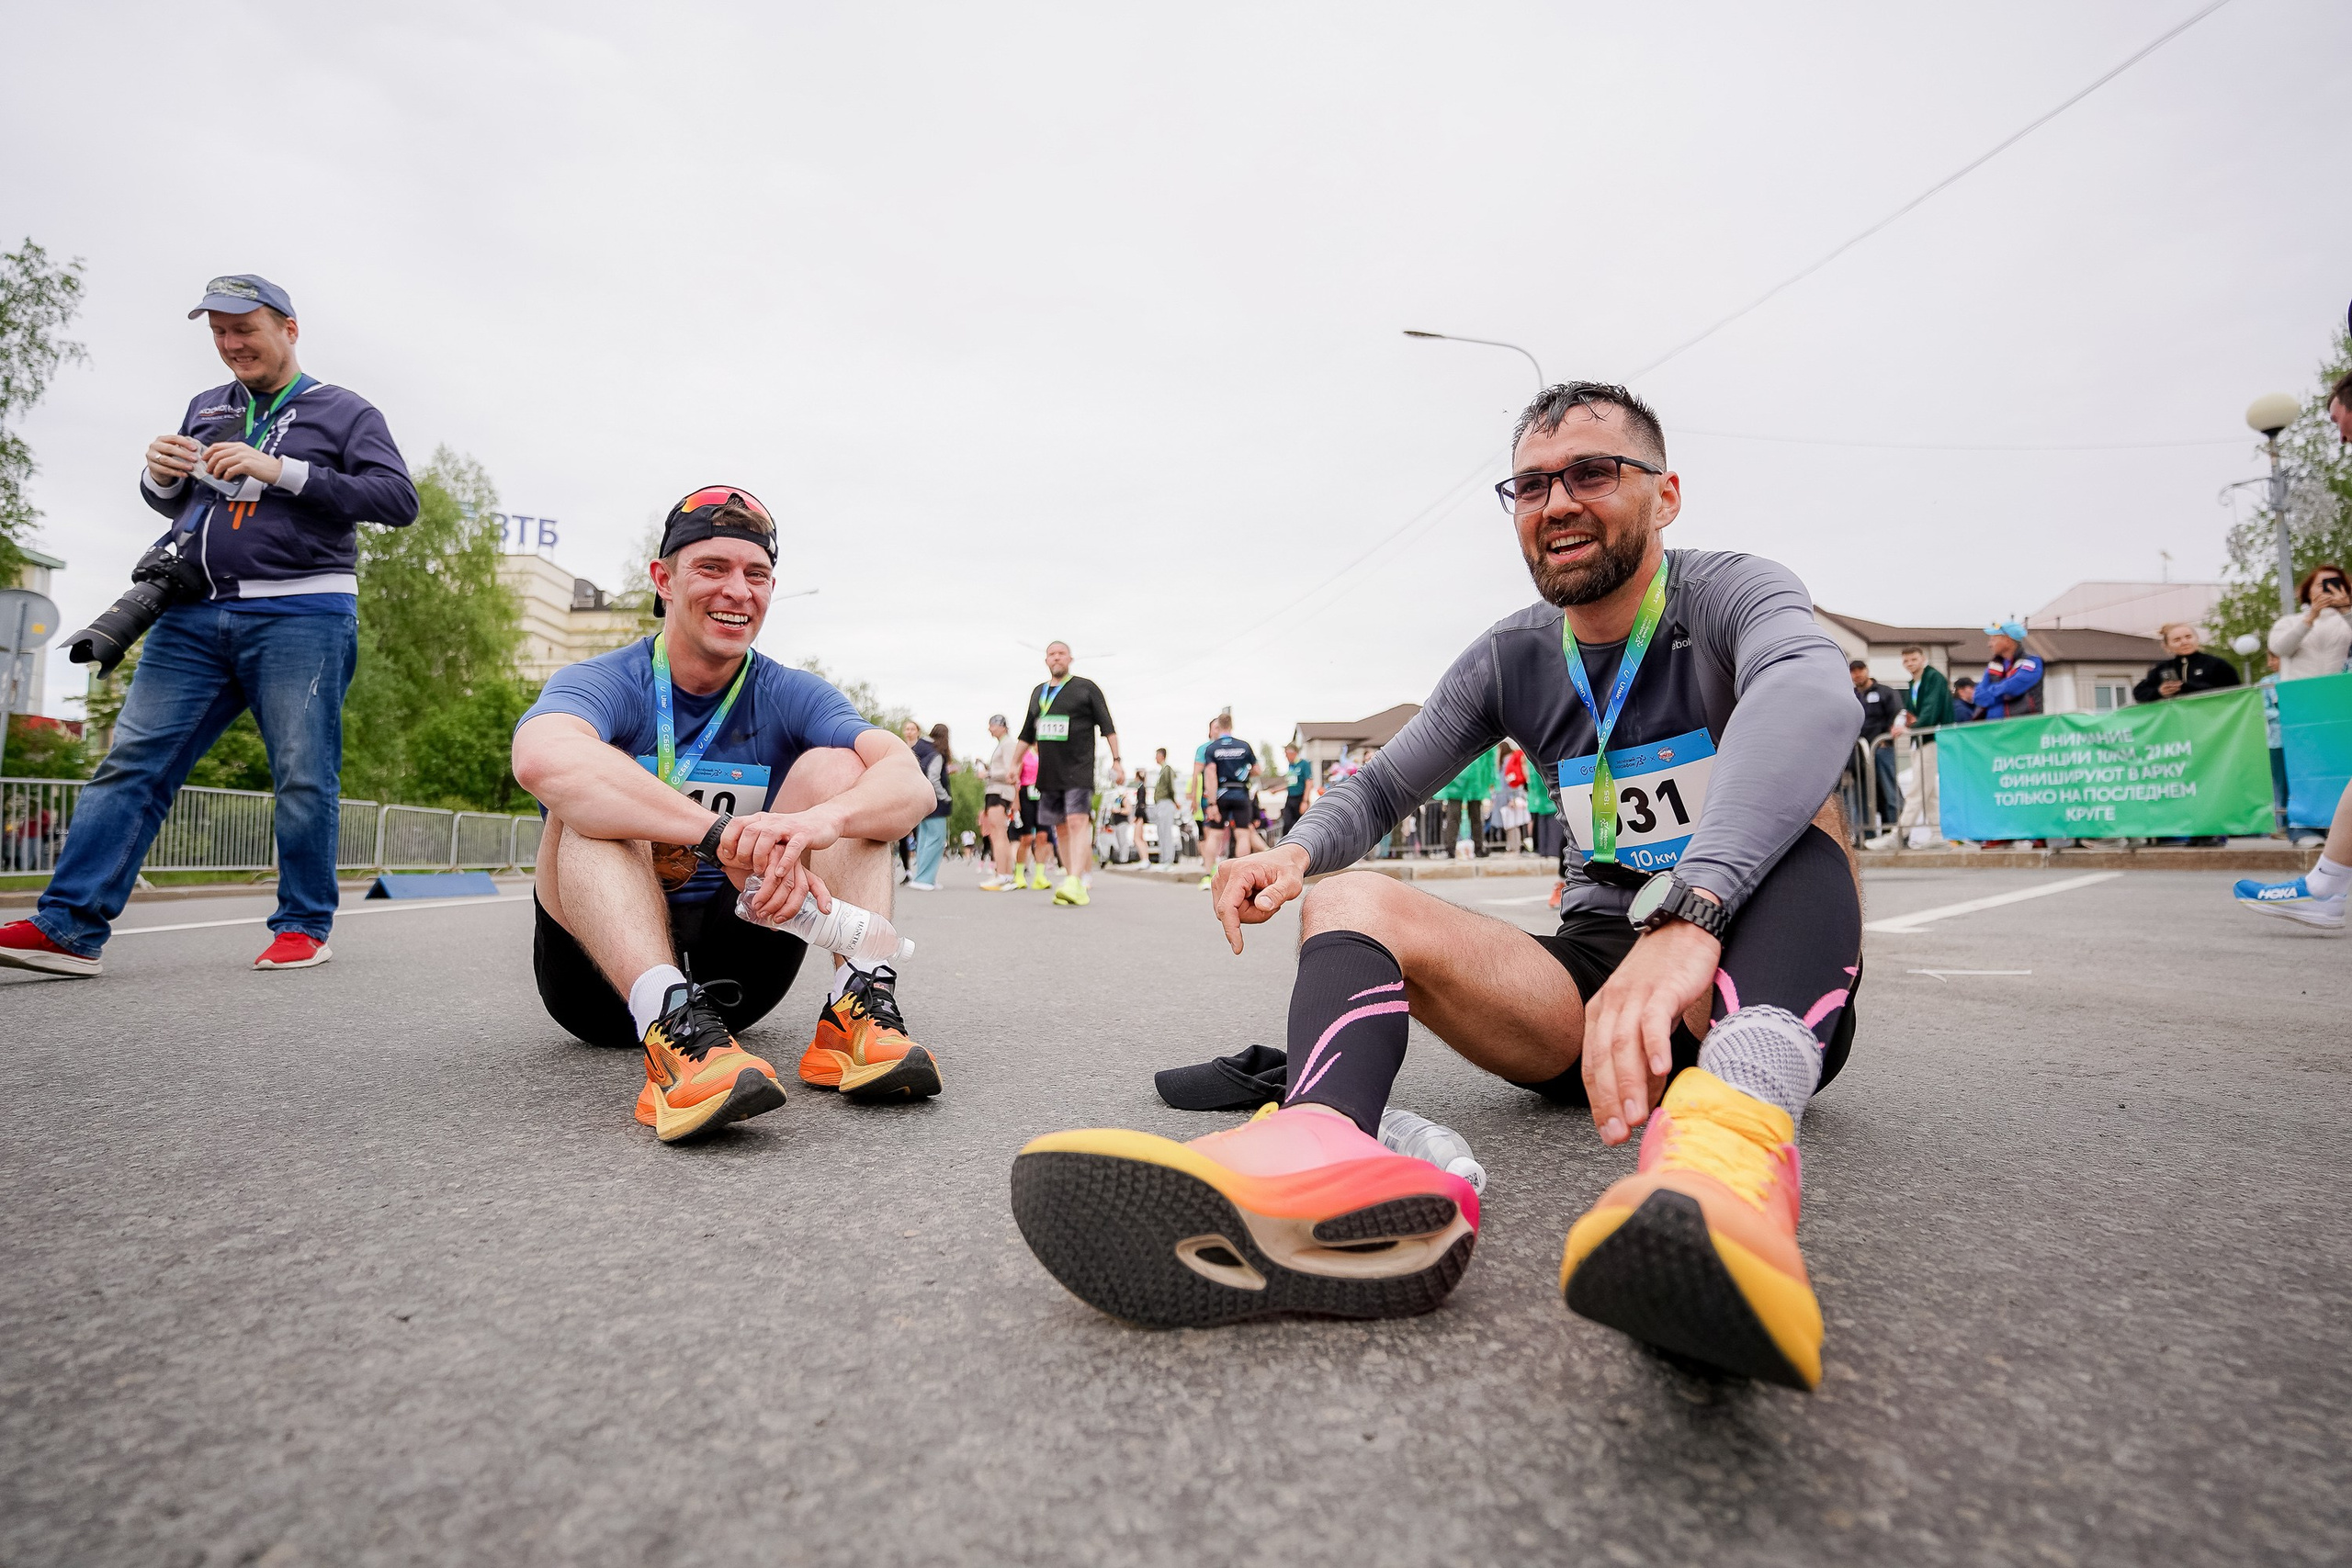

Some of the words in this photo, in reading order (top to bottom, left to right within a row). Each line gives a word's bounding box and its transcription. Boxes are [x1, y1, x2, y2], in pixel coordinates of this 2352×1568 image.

[490, 513, 559, 547] ВТБ
[1672, 637, 1692, 650] ebok
[1615, 681, 1626, 700] Utair
[662, 733, 671, 753] СБЕР
[703, 728, 713, 742] Utair
[2040, 728, 2134, 750] ВНИМАНИЕ
[1992, 750, 2092, 773] ДИСТАНЦИИ
[2144, 744, 2160, 761] 21
[2164, 740, 2192, 757] КМ
[677, 759, 691, 777] СБЕР
[1998, 765, 2125, 789] ФИНИШИРУЮТ
[2127, 765, 2139, 782] В
[2142, 761, 2187, 780] АРКУ
[1994, 788, 2057, 807] ТОЛЬКО
[2060, 787, 2080, 804] НА
[2082, 781, 2197, 803] ПОСЛЕДНЕМ
[1589, 778, 1690, 838] 31
[2064, 805, 2116, 822] КРУГЕ
[1630, 849, 1653, 868] 10
[2257, 886, 2298, 899] HOKA
